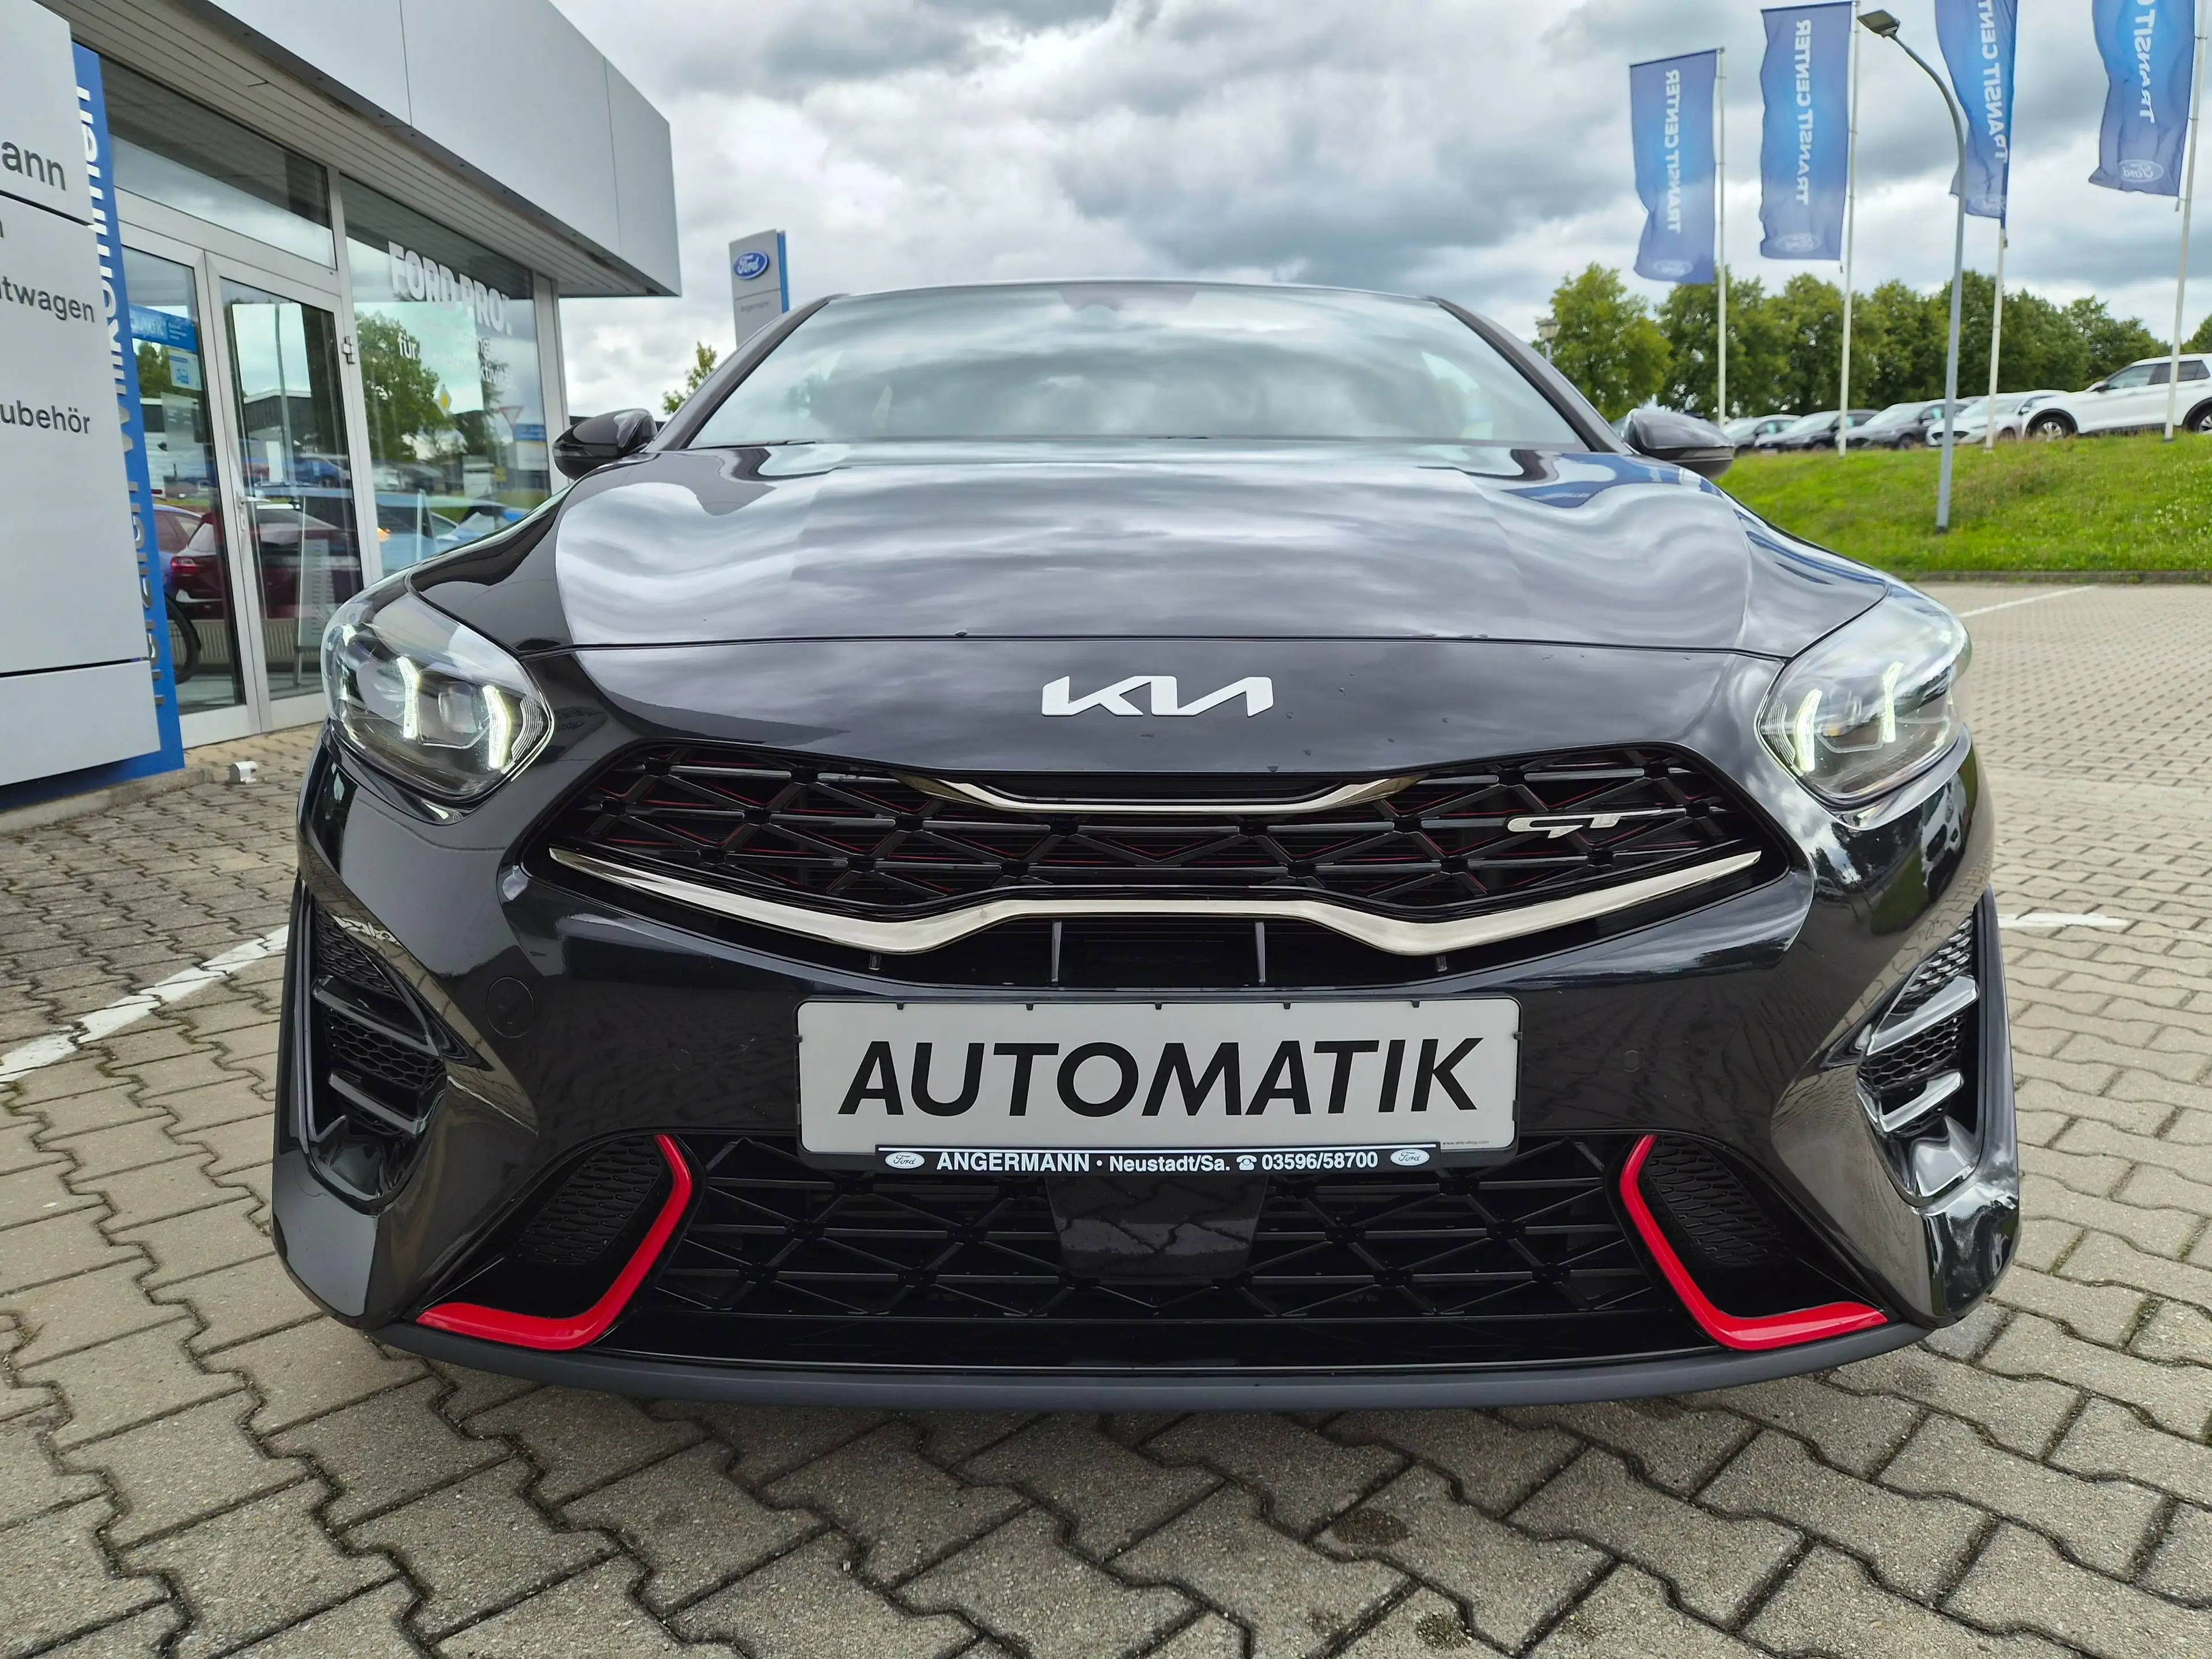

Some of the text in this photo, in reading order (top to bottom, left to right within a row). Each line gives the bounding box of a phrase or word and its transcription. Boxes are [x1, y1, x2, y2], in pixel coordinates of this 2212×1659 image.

[0, 276, 94, 323] twagen
[388, 241, 456, 312] FORD
[838, 1037, 1484, 1118] AUTOMATIK
[893, 1151, 1422, 1172] Ford ANGERMANN Neustadt/Sa. 03596/58700 Ford
